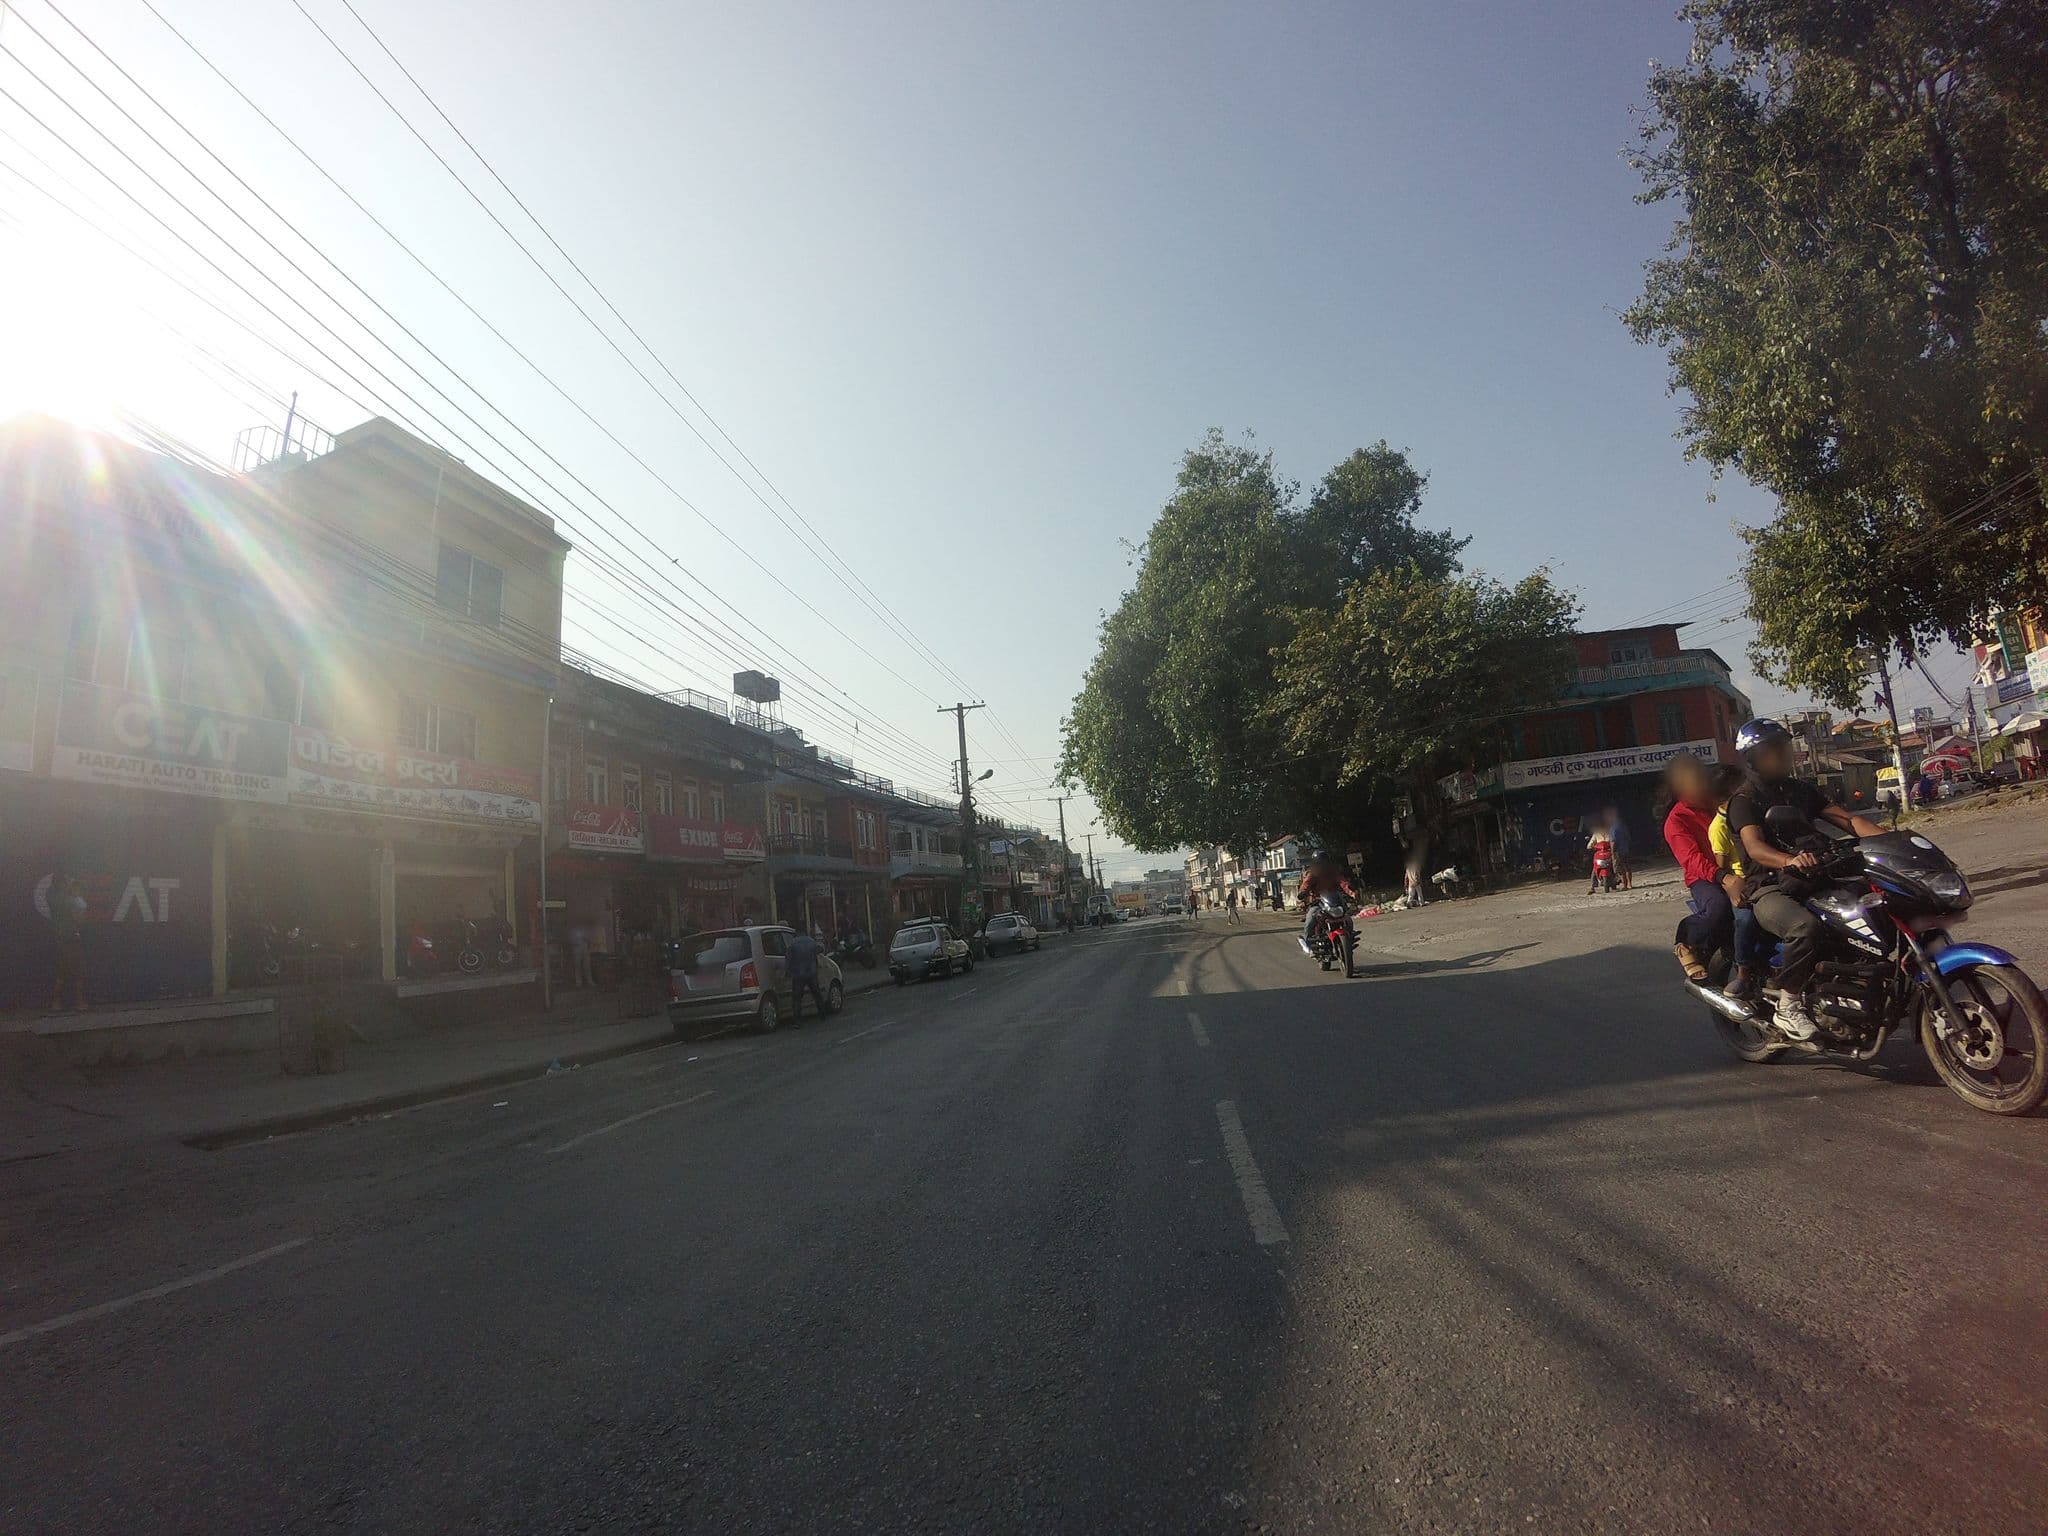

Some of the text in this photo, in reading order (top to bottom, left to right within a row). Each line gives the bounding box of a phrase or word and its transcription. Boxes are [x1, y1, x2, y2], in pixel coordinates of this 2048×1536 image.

[112, 702, 250, 764] CEAT
[77, 751, 146, 773] HARATI
[151, 762, 197, 780] AUTO
[200, 769, 272, 790] TRADING
[1587, 753, 1636, 769] यातायात
[1691, 743, 1713, 759] संघ
[1847, 937, 1882, 956] adidas
